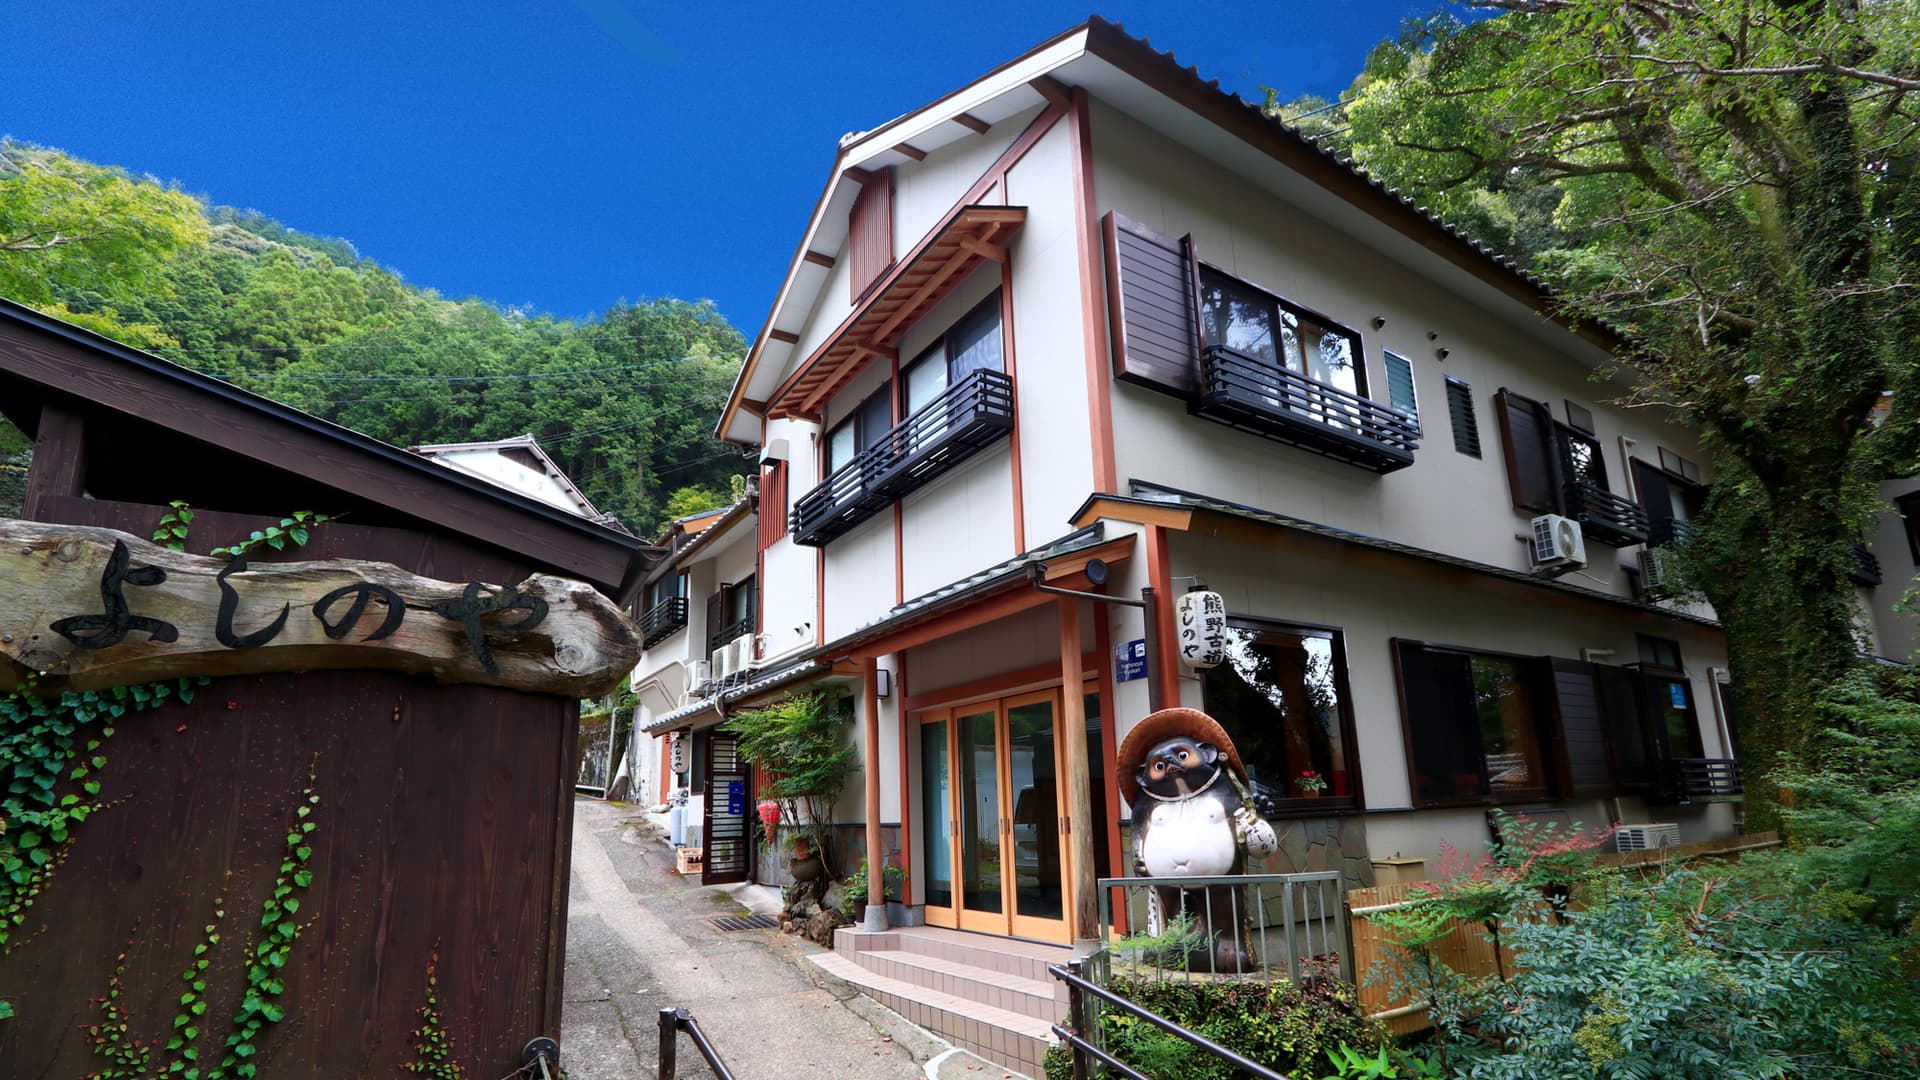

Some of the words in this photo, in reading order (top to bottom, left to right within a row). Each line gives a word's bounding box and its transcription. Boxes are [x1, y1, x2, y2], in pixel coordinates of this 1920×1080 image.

[50, 538, 549, 675] よしのや
[1180, 597, 1199, 658] よしのや
[1203, 595, 1224, 664] 熊野古道
